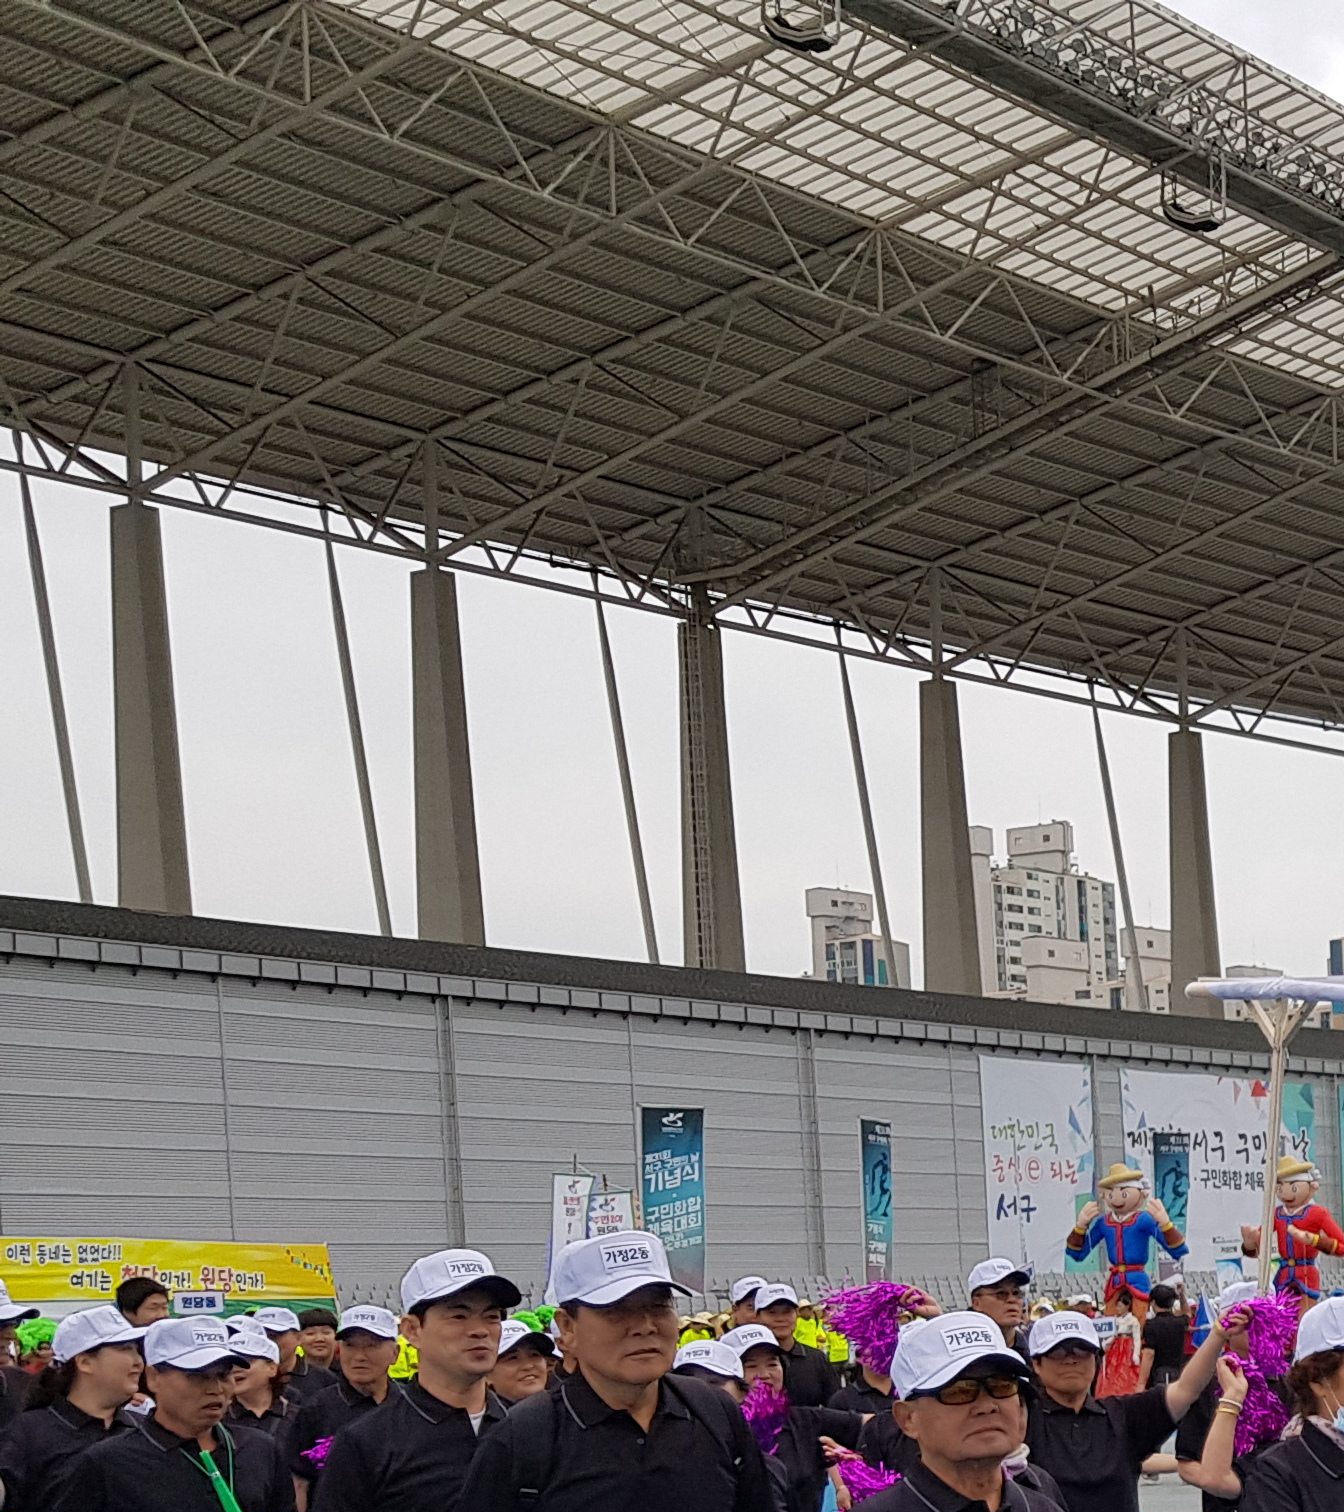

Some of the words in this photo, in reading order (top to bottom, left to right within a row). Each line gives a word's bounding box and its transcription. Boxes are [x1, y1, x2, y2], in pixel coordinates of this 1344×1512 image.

[990, 1117, 1058, 1154] 대한민국
[1193, 1130, 1225, 1163] 서구
[1236, 1131, 1270, 1164] 구민
[645, 1162, 699, 1193] 기념식
[1050, 1160, 1078, 1184] 되는
[1200, 1169, 1242, 1190] 구민화합
[1245, 1171, 1265, 1191] 체육
[647, 1196, 701, 1222] 구민화합
[996, 1193, 1037, 1223] 서구
[6, 1244, 31, 1264] 이런
[36, 1244, 72, 1264] 동네는
[77, 1244, 122, 1263] 없었다!!
[605, 1248, 650, 1263] 가정2동
[70, 1270, 112, 1292] 여기는
[200, 1266, 266, 1293] 원당인가!
[450, 1263, 485, 1275] 가정2동
[945, 1330, 992, 1346] 가정2동
